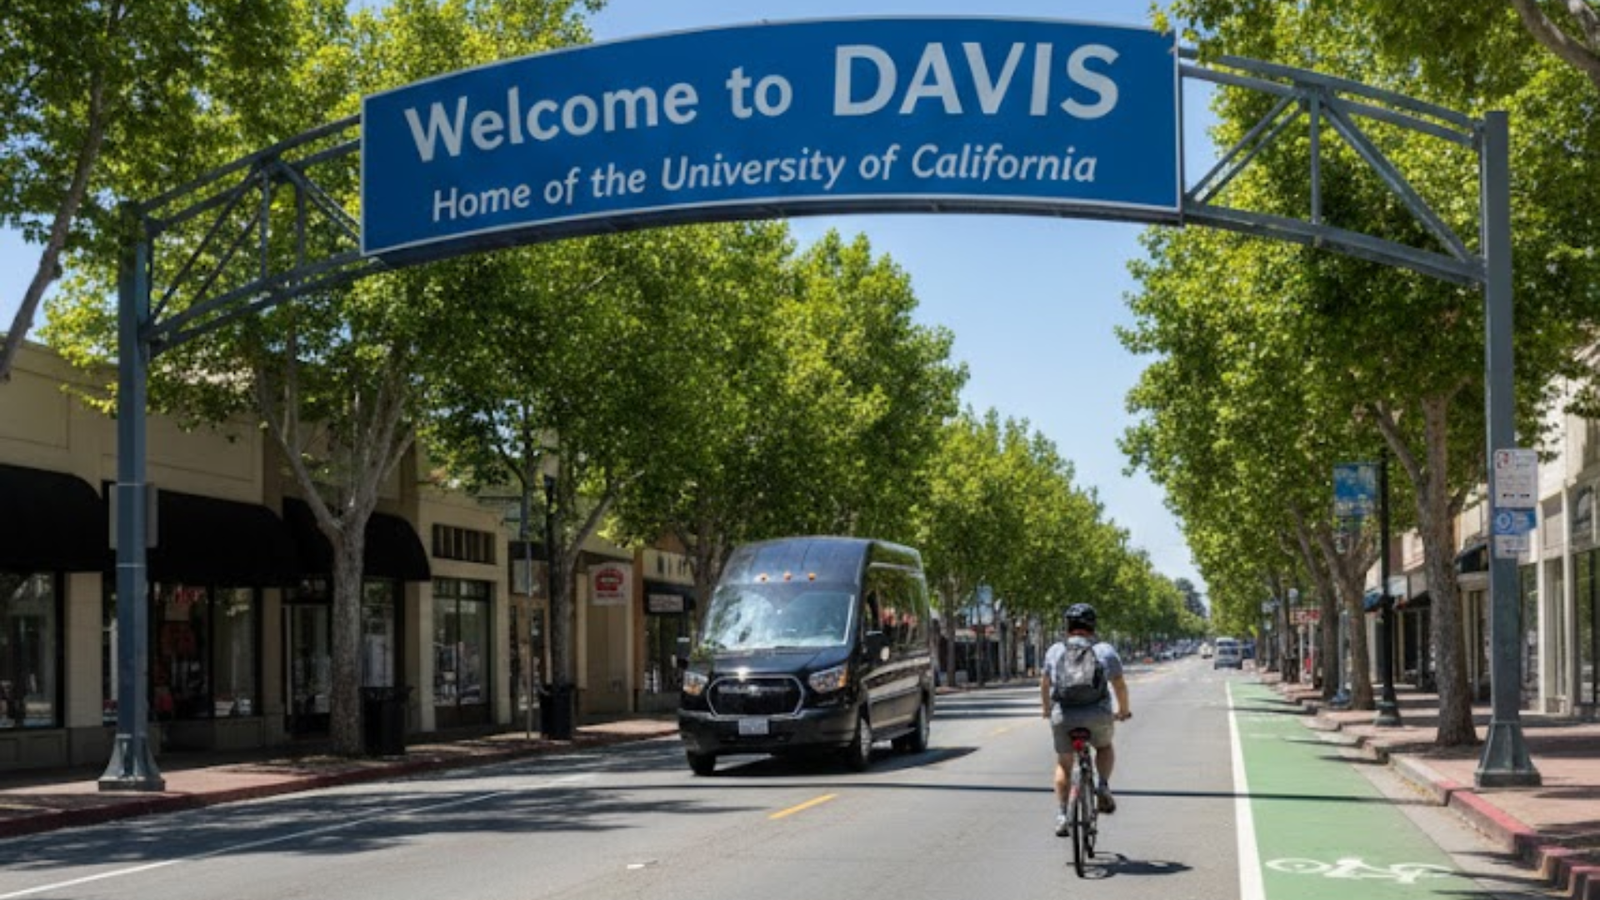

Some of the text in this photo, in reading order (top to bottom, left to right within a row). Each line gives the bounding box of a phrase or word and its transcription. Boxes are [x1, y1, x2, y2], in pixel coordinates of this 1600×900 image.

[405, 42, 1120, 161] Welcome to DAVIS
[433, 144, 1097, 221] Home of the University of California
